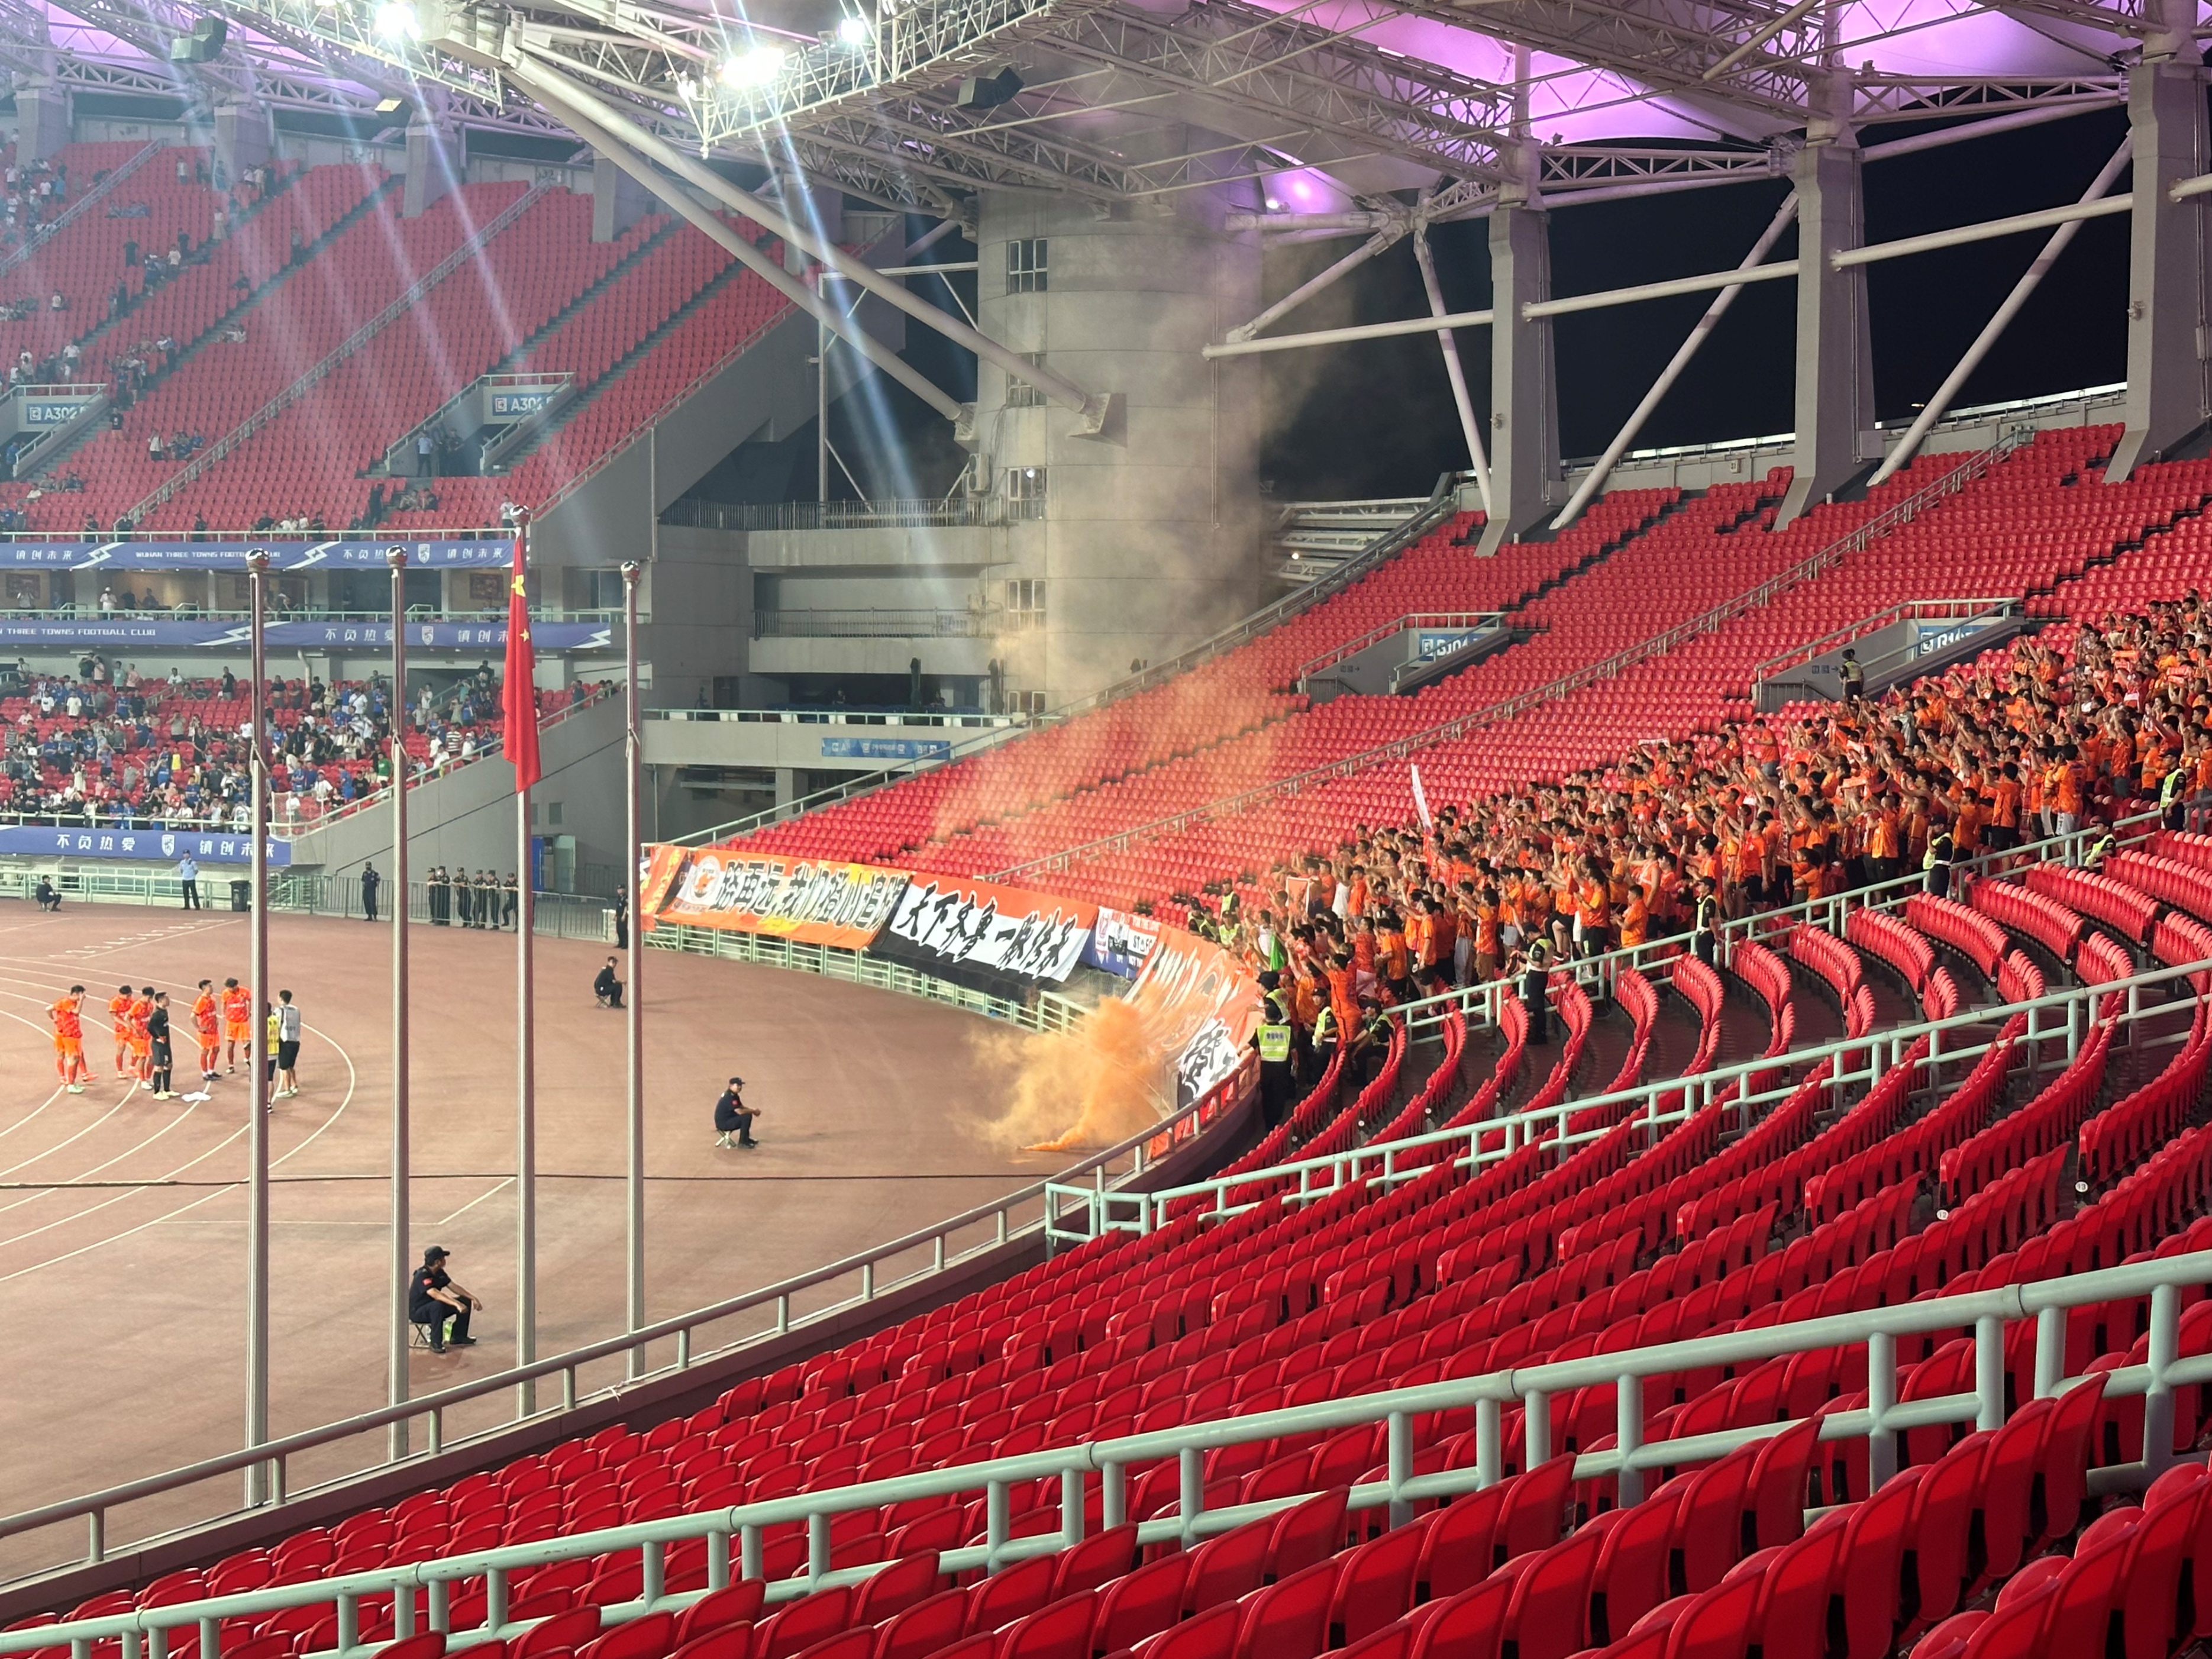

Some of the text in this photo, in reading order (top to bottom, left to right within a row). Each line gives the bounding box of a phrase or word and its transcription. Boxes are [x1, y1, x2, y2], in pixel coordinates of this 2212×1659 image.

[343, 548, 384, 560] 不负热
[458, 630, 509, 643] 镇创未
[57, 834, 135, 851] 不负热爱
